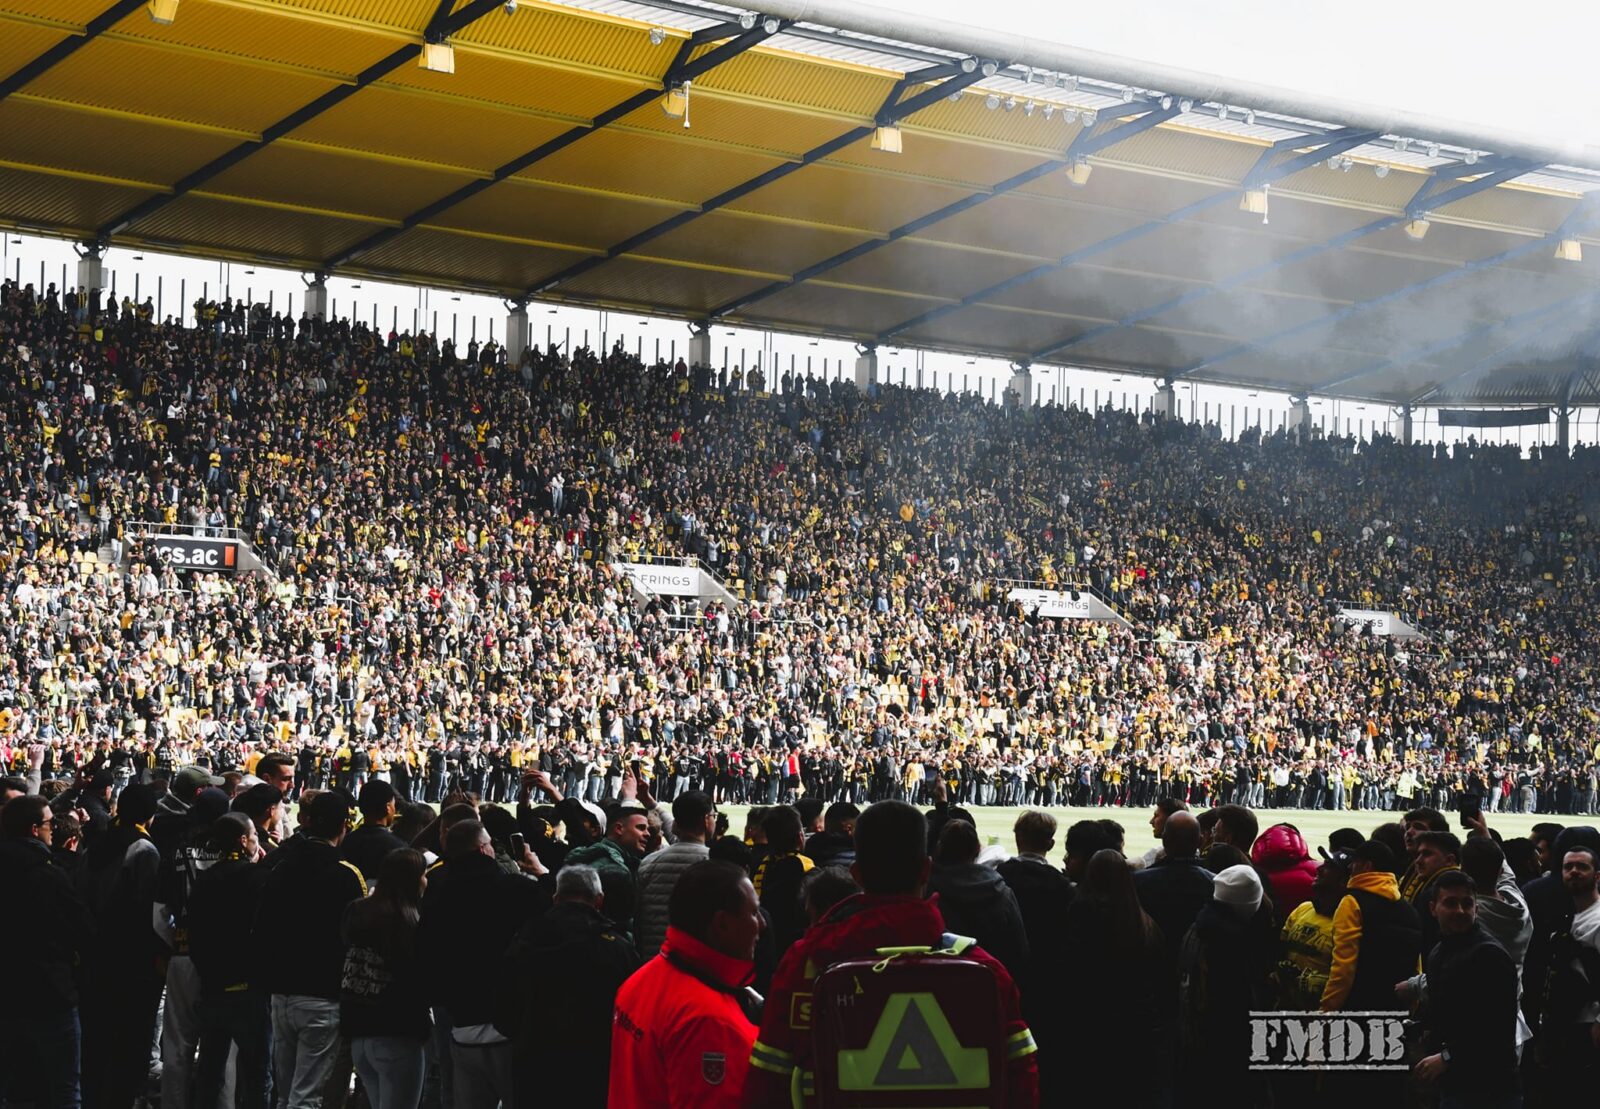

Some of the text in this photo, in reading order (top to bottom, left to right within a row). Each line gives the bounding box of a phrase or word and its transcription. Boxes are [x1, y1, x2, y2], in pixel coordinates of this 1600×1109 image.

[641, 574, 690, 587] FRINGS
[1051, 600, 1089, 610] FRINGS
[836, 993, 855, 1007] H1
